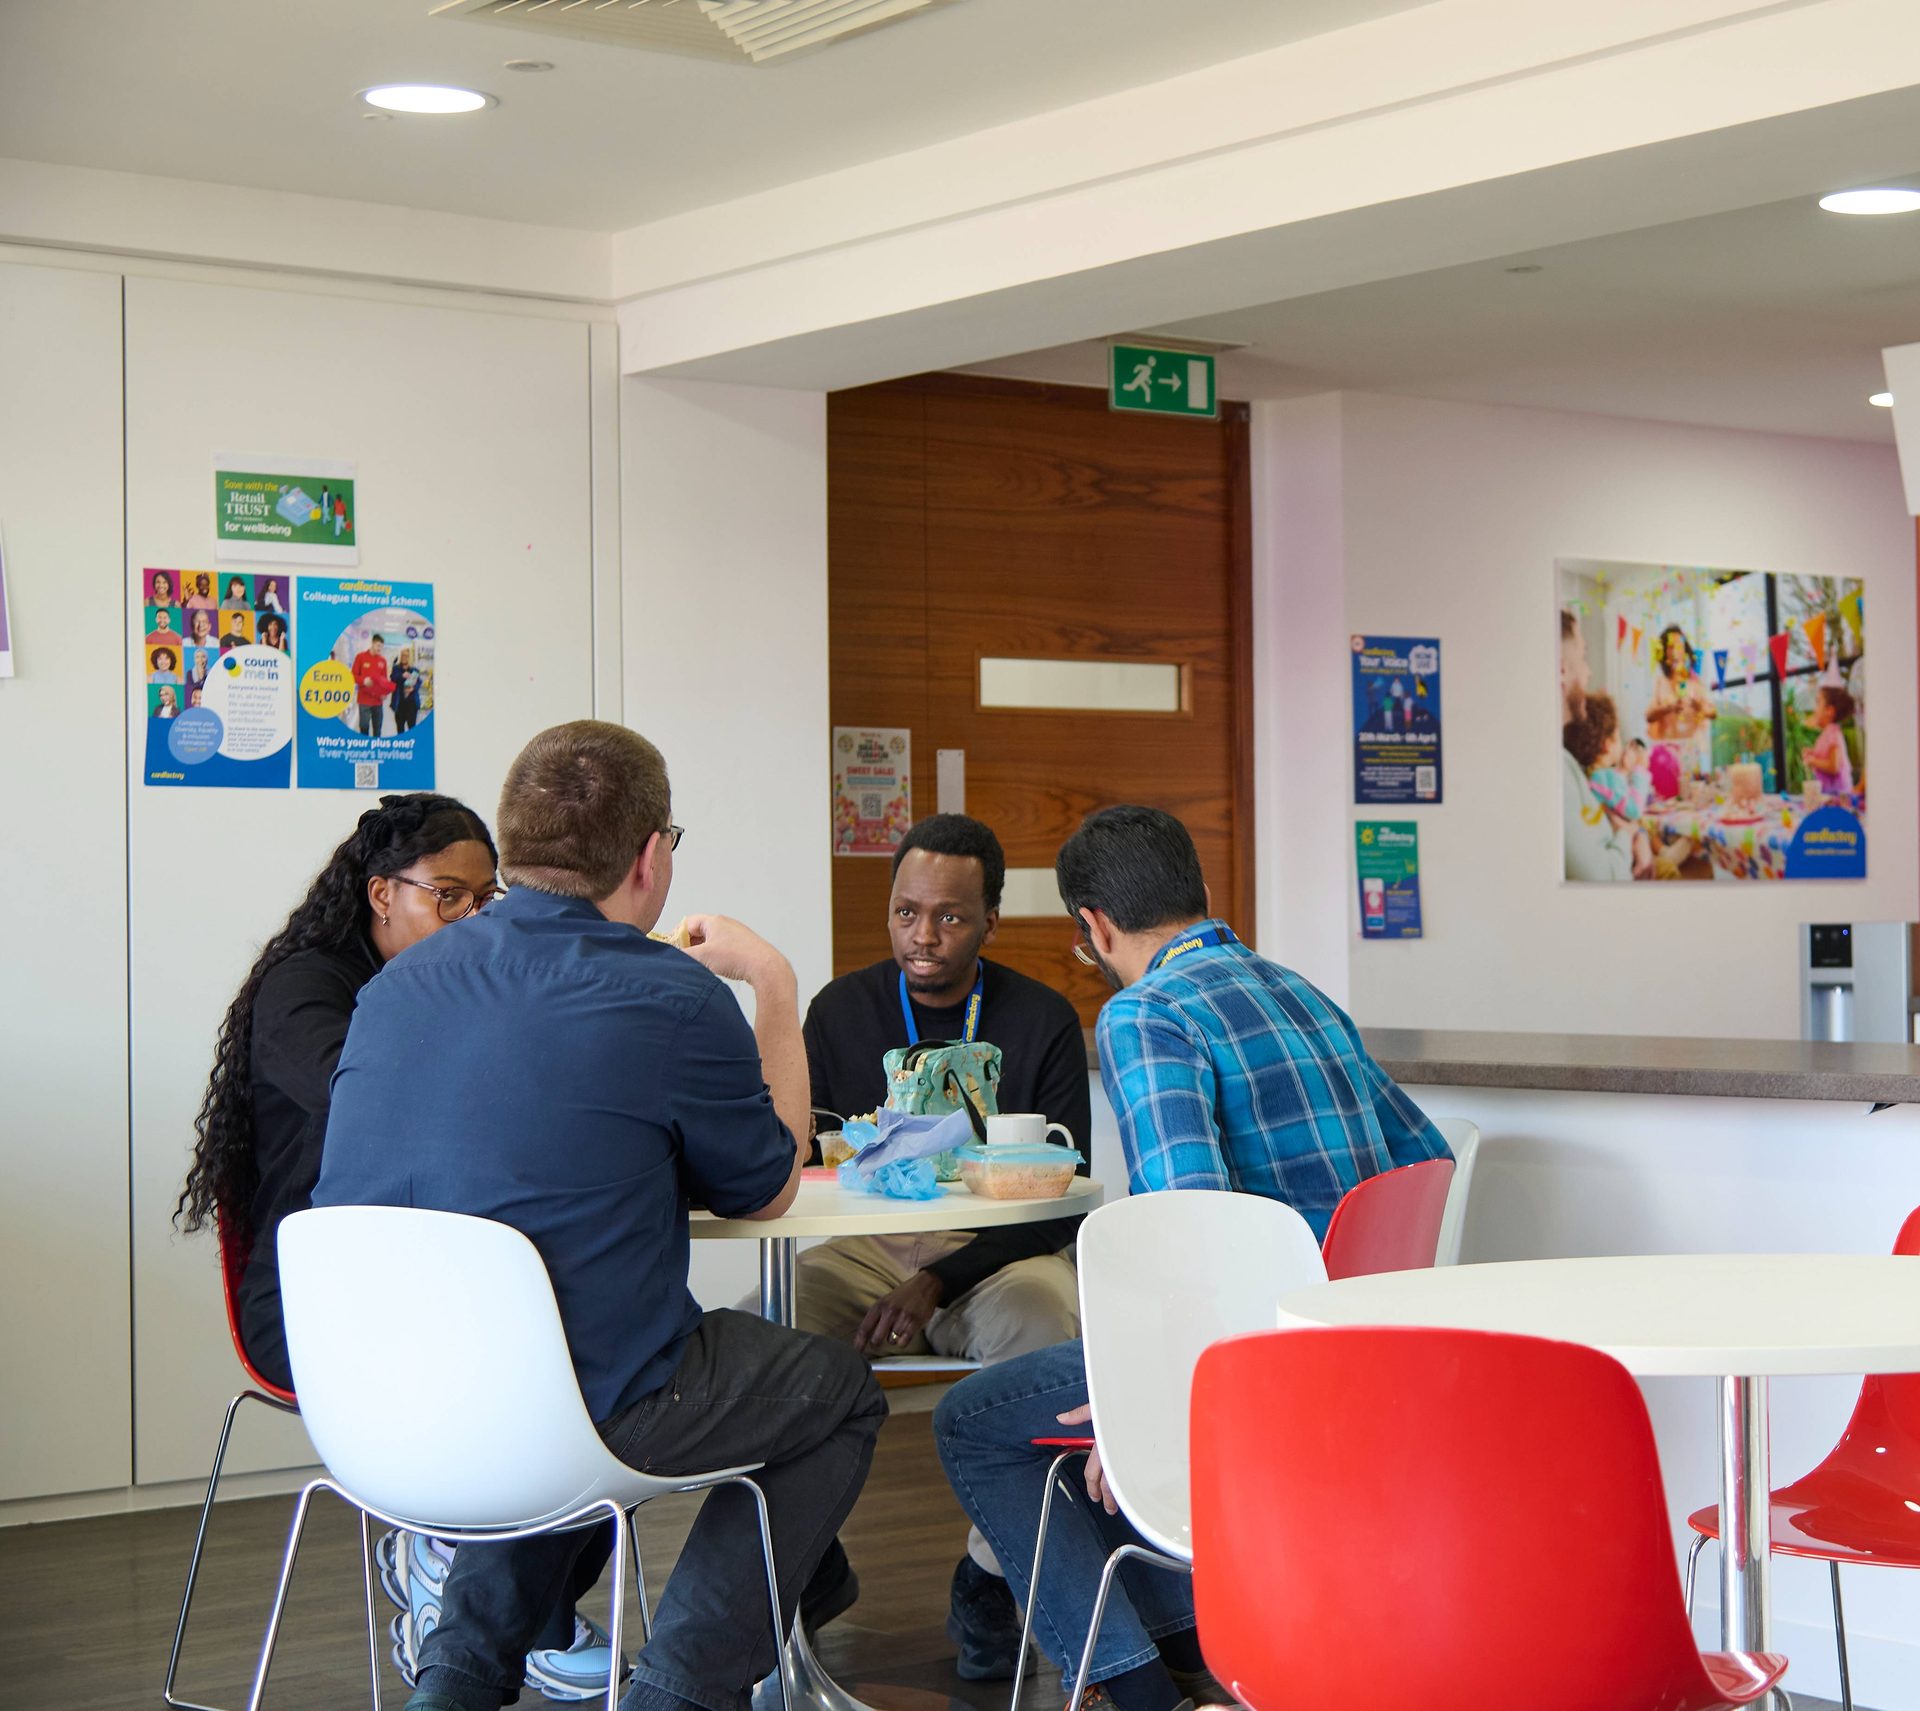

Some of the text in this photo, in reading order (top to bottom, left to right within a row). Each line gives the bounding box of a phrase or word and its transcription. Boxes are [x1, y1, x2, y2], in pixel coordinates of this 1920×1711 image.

[224, 480, 278, 492] Save with the
[230, 492, 265, 504] Retail
[224, 503, 271, 516] TRUST
[224, 521, 292, 536] for wellbeing
[339, 580, 392, 595] cardfactory
[303, 591, 428, 607] Colleague Referral Scheme
[244, 658, 278, 668] count
[244, 669, 278, 680] me in
[313, 670, 342, 682] Earn
[304, 690, 351, 704] £1,000
[316, 736, 415, 749] Who's your plus one?
[319, 748, 376, 760] Everyone's
[151, 771, 184, 780] cardfactory
[1804, 827, 1857, 848] cardfactory
[966, 994, 981, 1042] cardfactory
